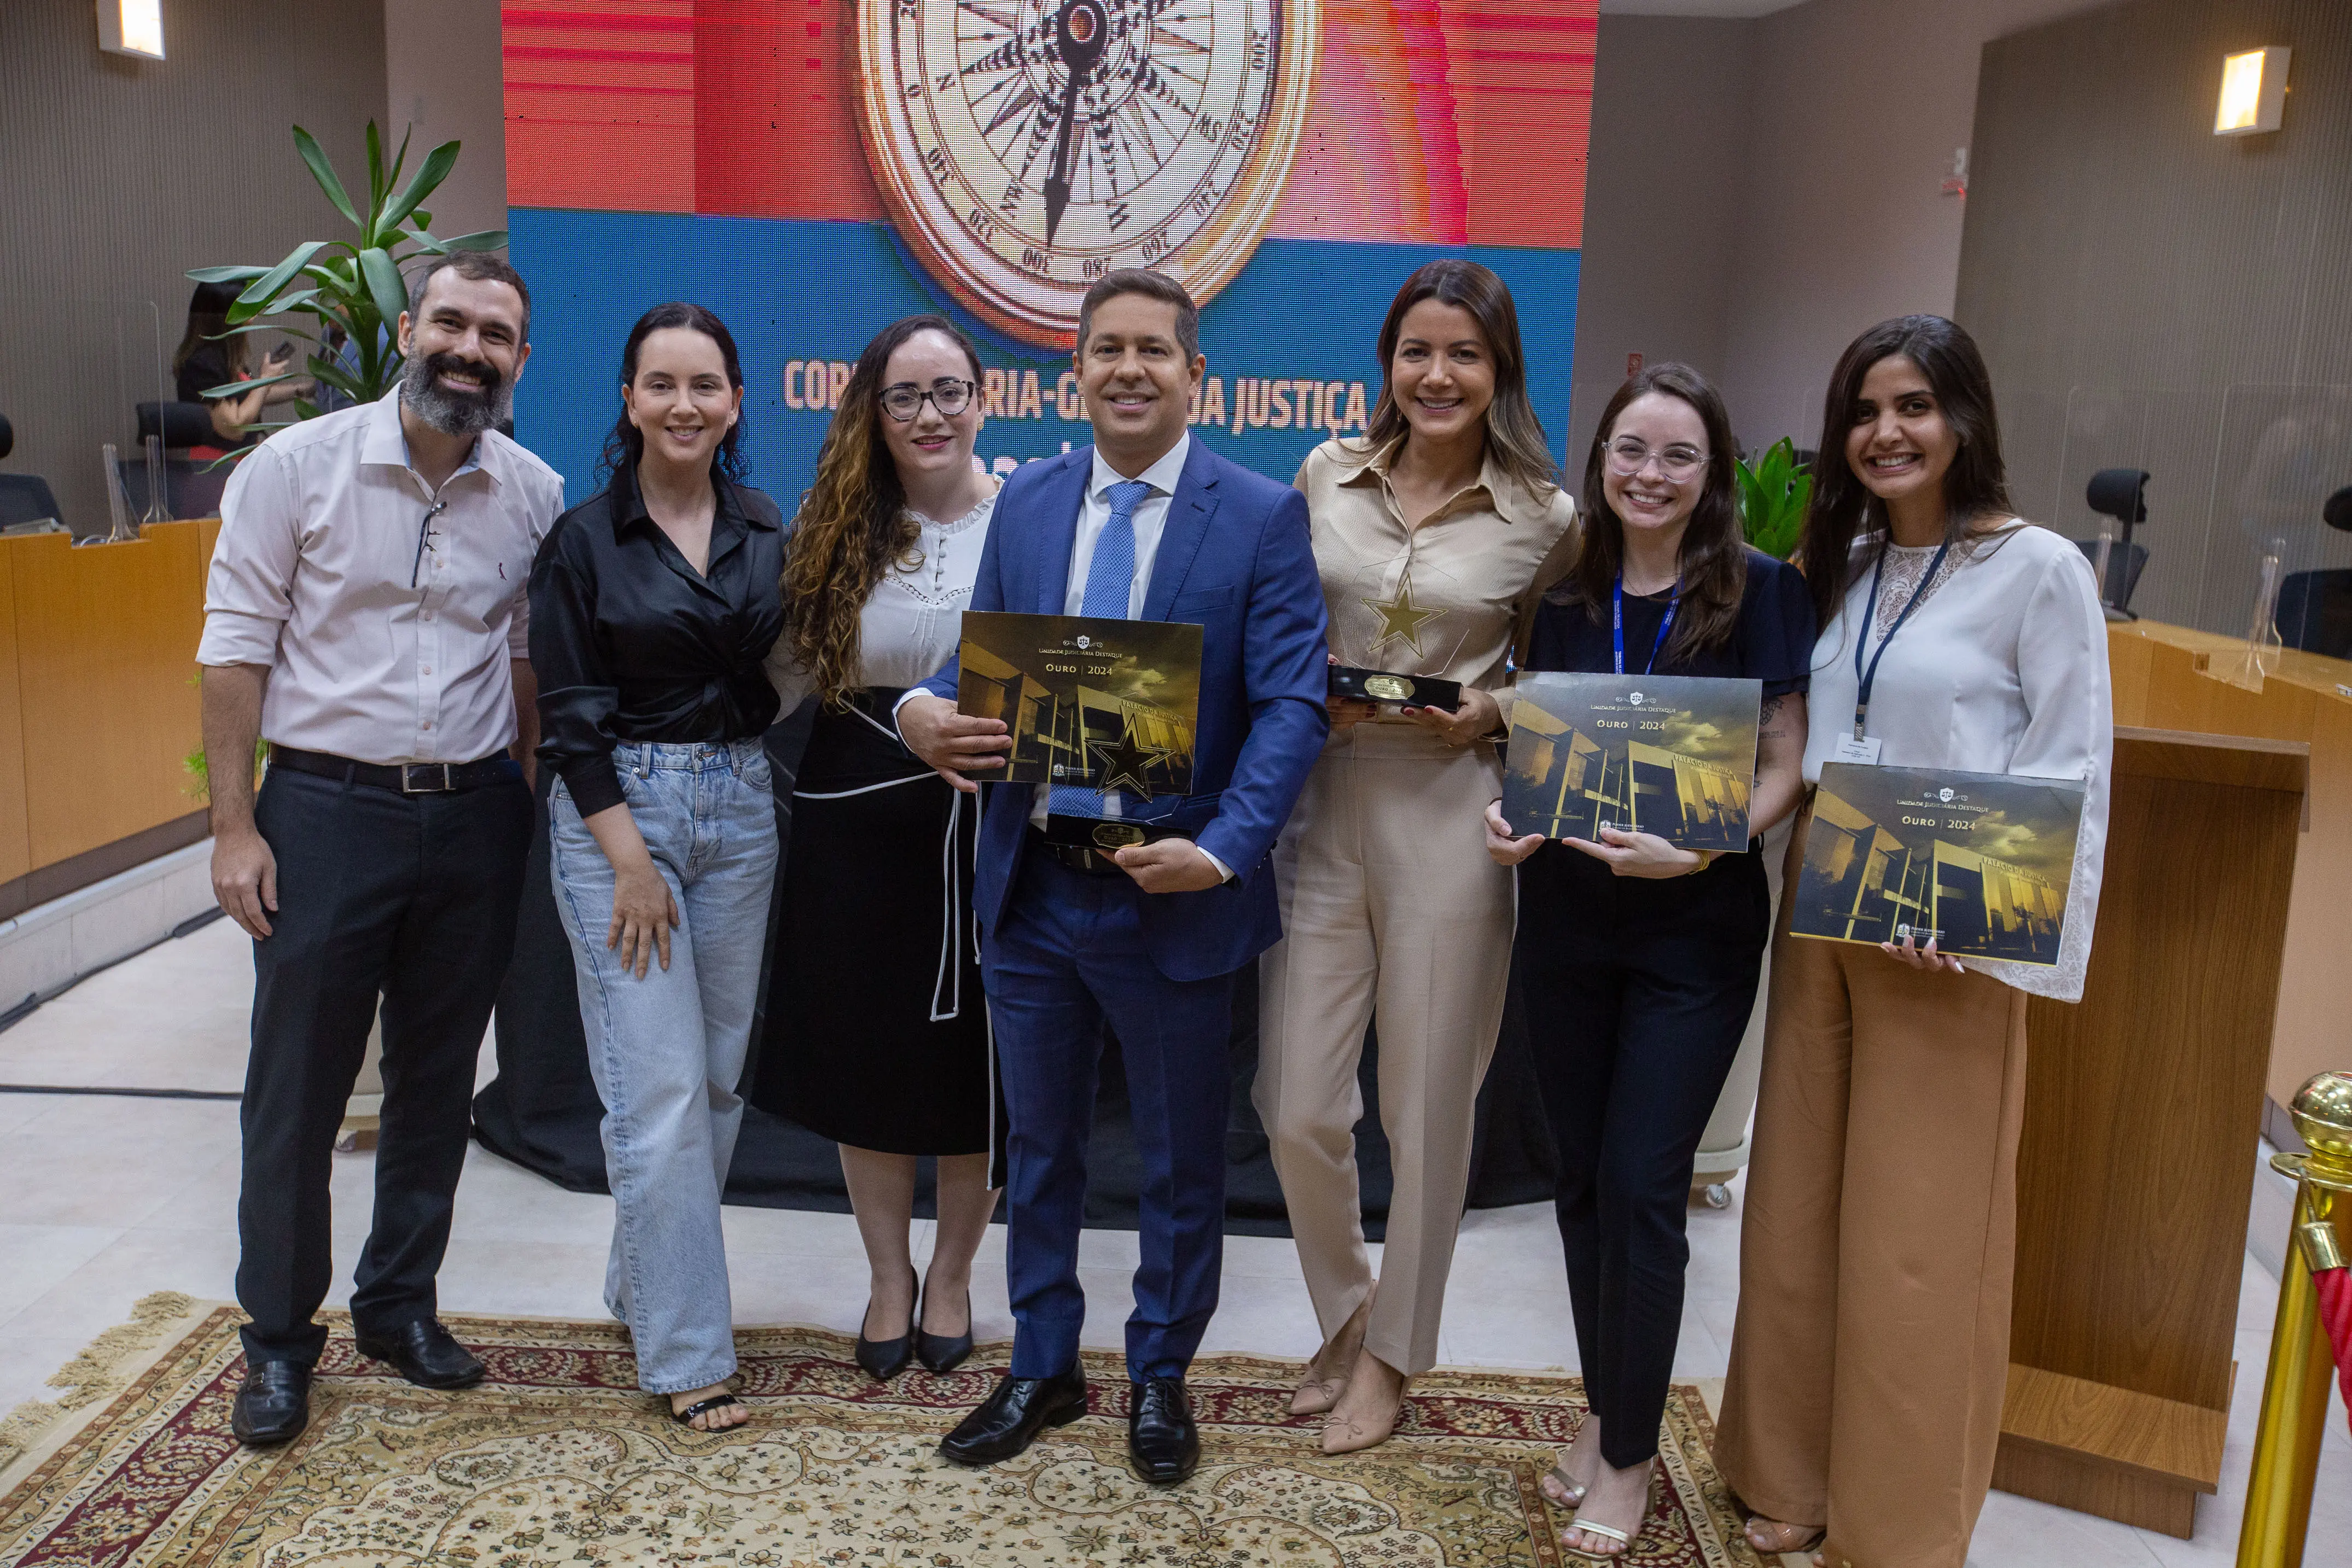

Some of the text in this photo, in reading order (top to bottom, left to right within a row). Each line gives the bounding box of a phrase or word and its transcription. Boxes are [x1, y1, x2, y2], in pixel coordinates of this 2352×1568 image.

[1230, 378, 1368, 440] JUSTIÇA
[1046, 663, 1113, 675] OURO 2024
[1597, 720, 1666, 731] OURO 2024
[1902, 815, 1976, 831] OURO 2024
